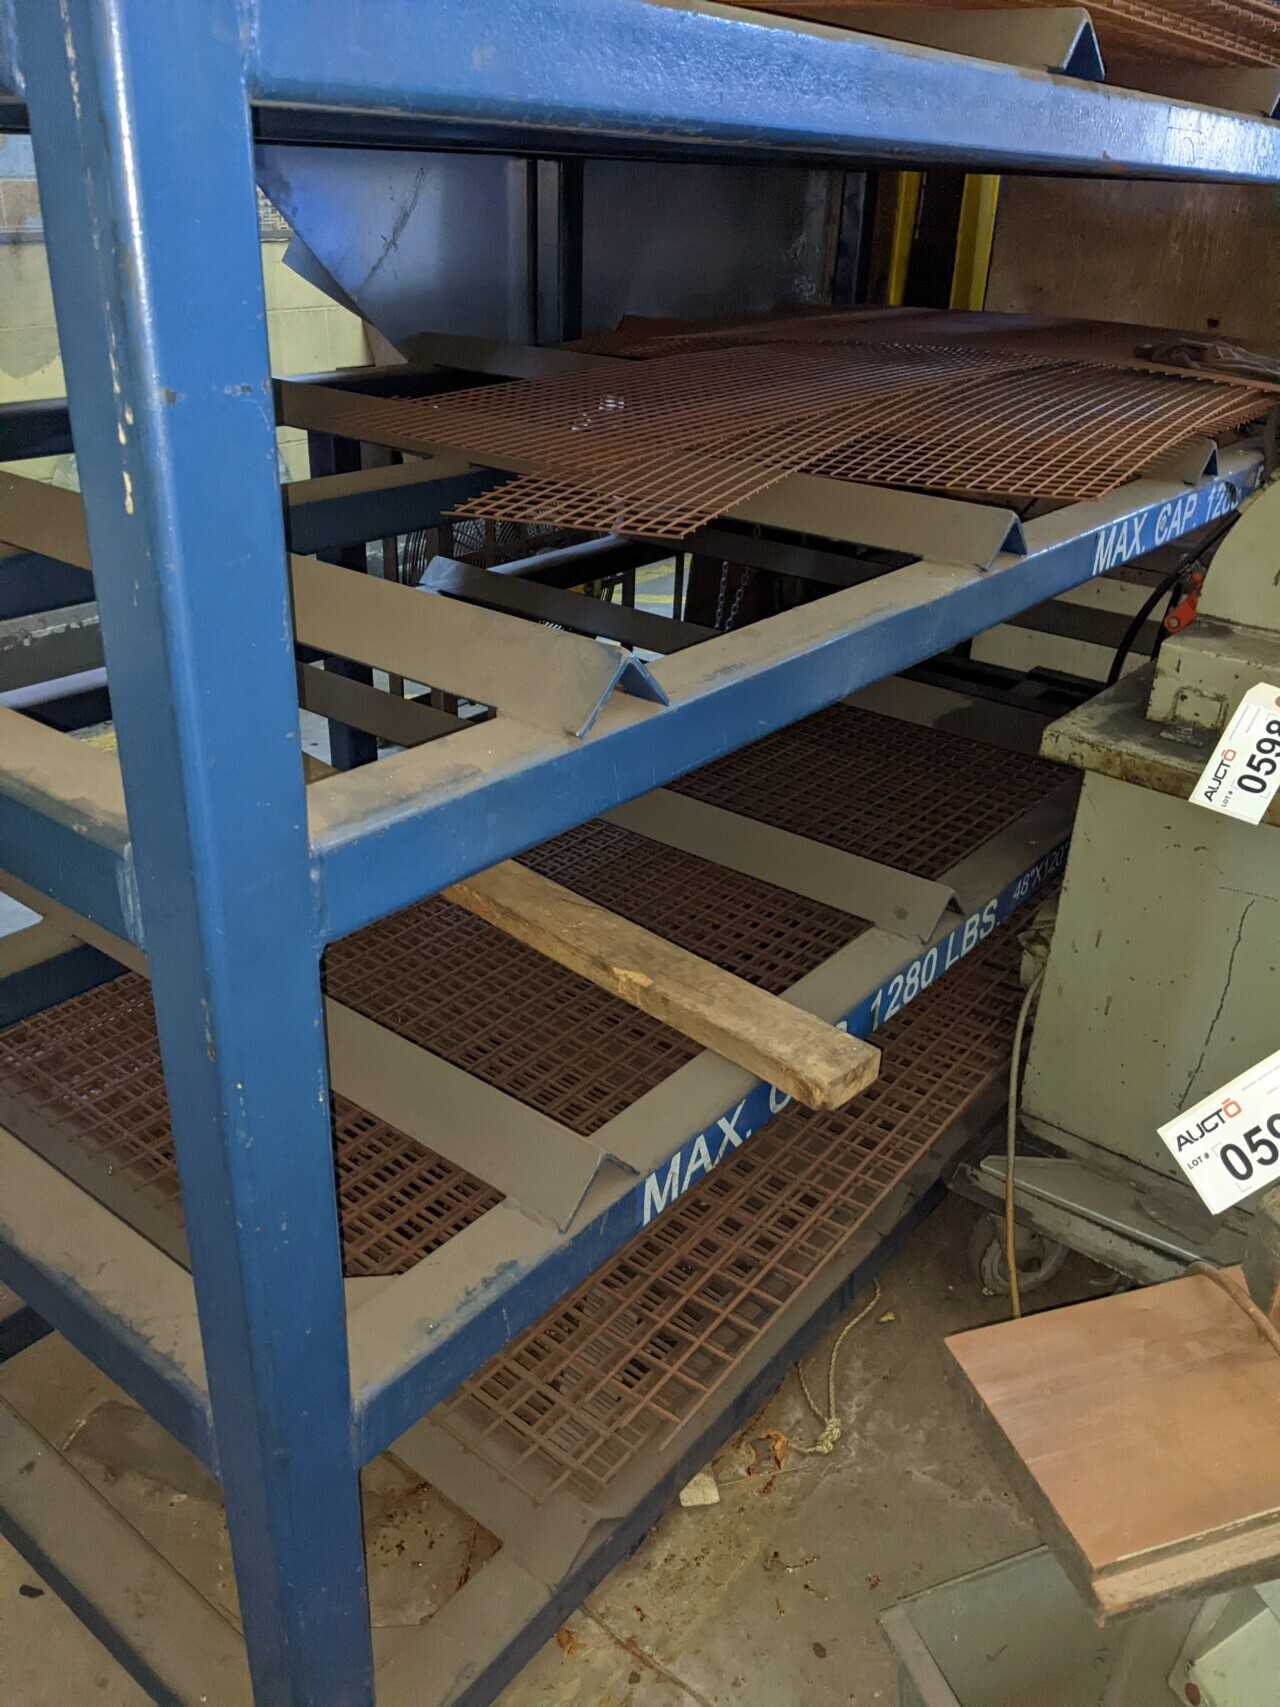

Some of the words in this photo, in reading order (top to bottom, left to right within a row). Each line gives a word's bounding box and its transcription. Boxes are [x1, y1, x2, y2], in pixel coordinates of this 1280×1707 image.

[1092, 512, 1149, 576] MAX.
[1154, 492, 1198, 546] CAP.
[642, 1098, 752, 1226] MAX.
[870, 947, 938, 1032] 1280
[944, 898, 1001, 971] LBS.
[1187, 1155, 1204, 1170] LOT
